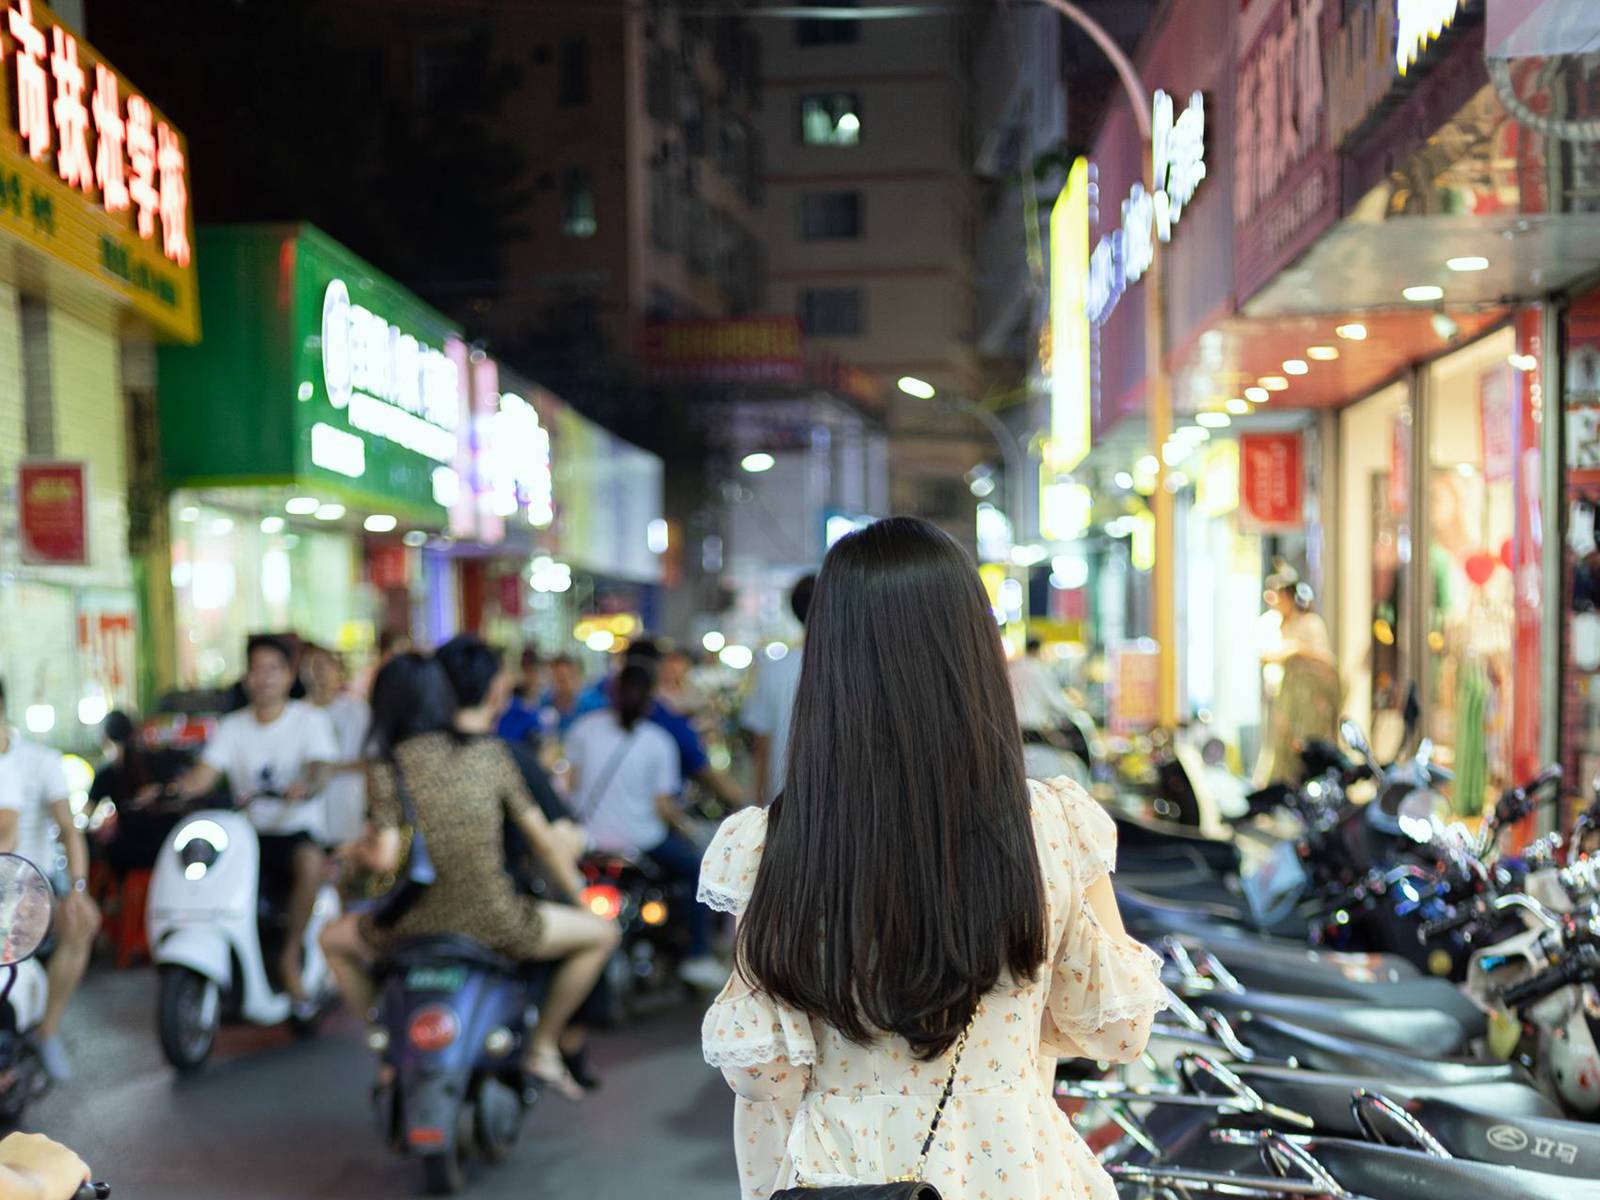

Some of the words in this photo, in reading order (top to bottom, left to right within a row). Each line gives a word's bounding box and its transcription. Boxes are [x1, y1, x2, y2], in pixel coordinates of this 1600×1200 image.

[0, 0, 190, 268] 市扶壮学校
